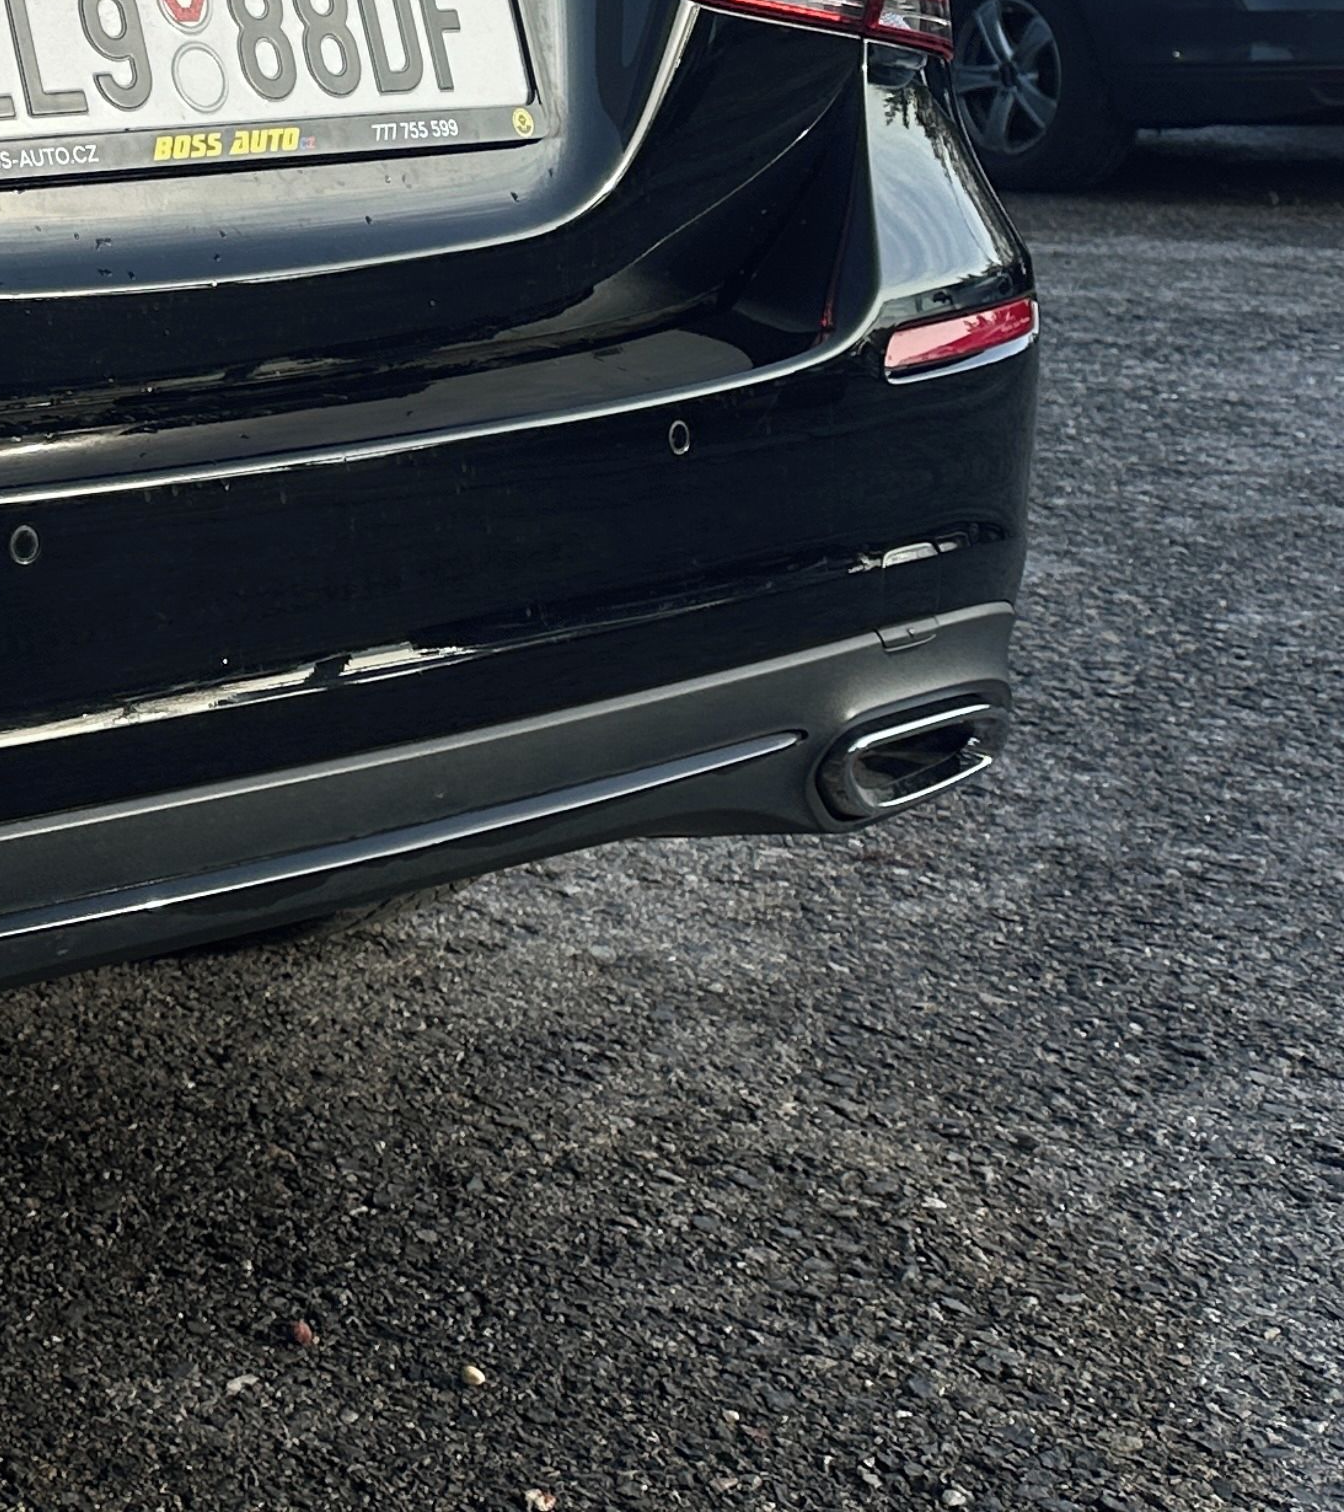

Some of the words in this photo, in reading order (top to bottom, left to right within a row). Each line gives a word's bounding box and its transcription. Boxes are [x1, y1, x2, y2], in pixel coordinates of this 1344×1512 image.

[153, 132, 223, 161] BOSS
[229, 127, 301, 155] AUTO
[371, 123, 397, 142] 777
[399, 121, 429, 139] 755
[430, 118, 459, 137] 599
